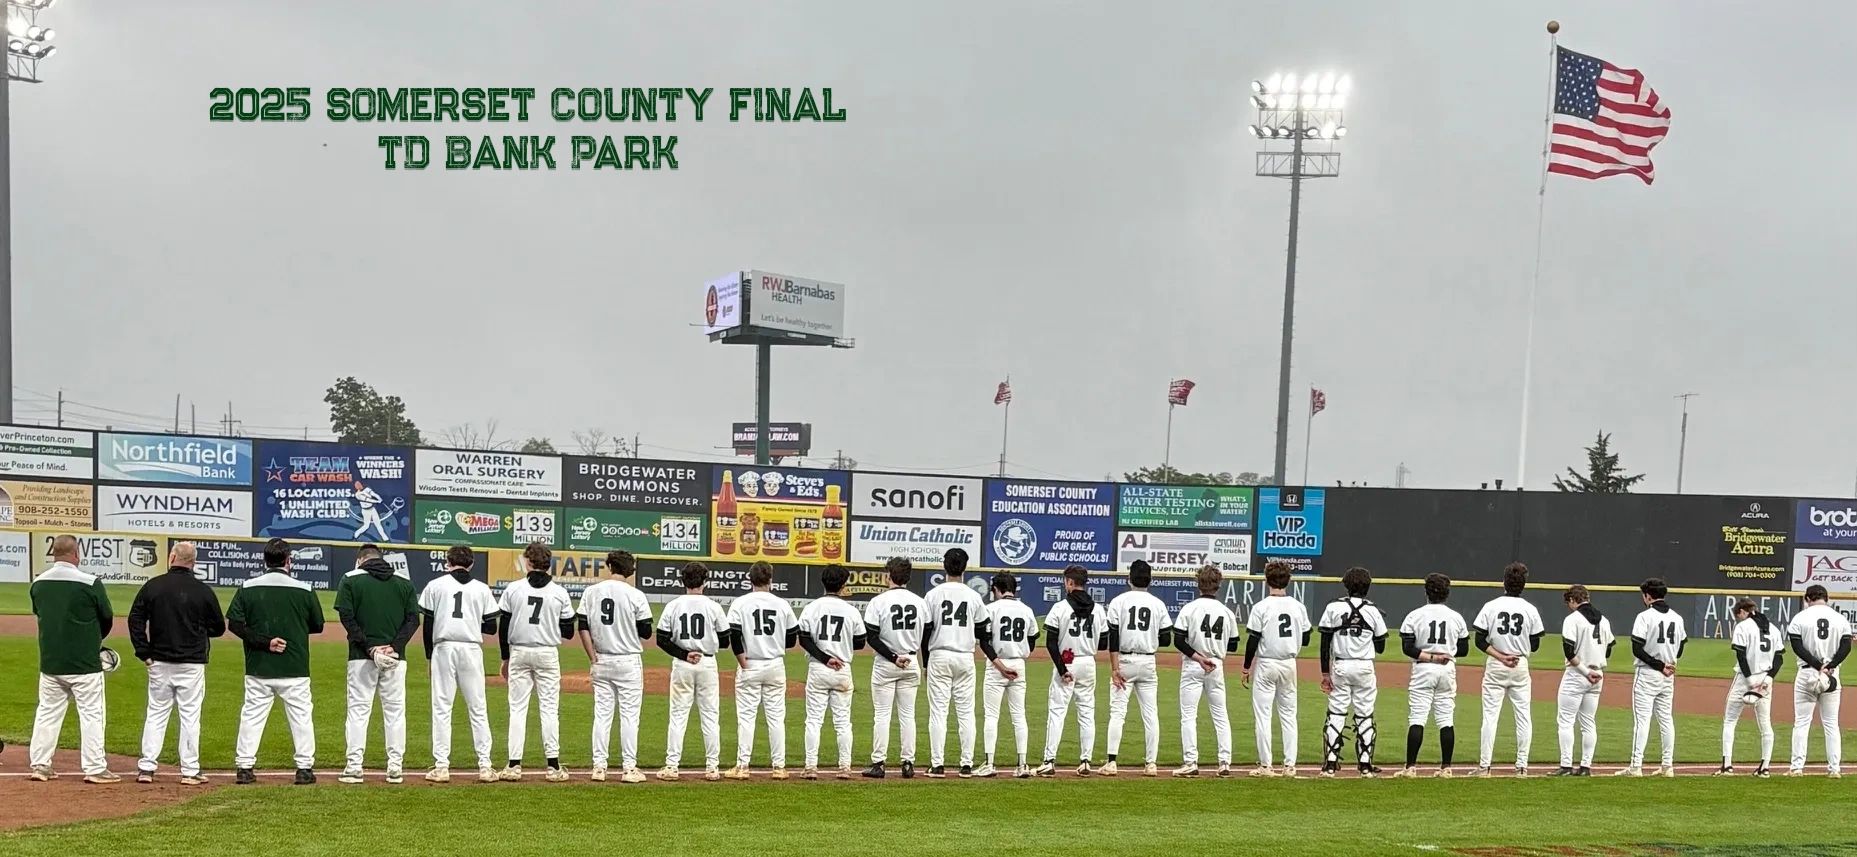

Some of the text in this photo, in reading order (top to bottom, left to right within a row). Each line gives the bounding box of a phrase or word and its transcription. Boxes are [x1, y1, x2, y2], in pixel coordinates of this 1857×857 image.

[762, 276, 835, 301] RWJBarnabas
[771, 292, 803, 305] HEALTH
[41, 446, 72, 455] Collection
[112, 439, 237, 465] Northfield
[11, 460, 68, 471] Peace of Mind.
[290, 456, 350, 474] TEAM
[355, 460, 405, 469] WINNERS
[456, 453, 522, 467] WARREN
[202, 466, 236, 479] Bank
[289, 473, 353, 483] CAR WASH
[359, 468, 403, 479] WASH!
[432, 464, 545, 480] ORAL SURGERY
[579, 463, 696, 480] BRIDGEWATER
[454, 478, 506, 486] COMPASSIONATE
[594, 478, 680, 493] COMMONS
[785, 474, 825, 487] Steve's
[28, 494, 66, 502] Construction
[53, 487, 85, 495] Landscape
[273, 488, 355, 498] 16 LOCATIONS.
[449, 485, 468, 493] Teeth
[469, 486, 498, 495] Removal
[530, 490, 559, 498] Implants
[870, 484, 964, 511] sanofi
[1006, 484, 1097, 500] SOMERSET COUNTY
[1123, 487, 1183, 498] ALL-STATE
[117, 493, 233, 513] WYNDHAM
[279, 500, 350, 510] 1 UNLIMITED
[572, 492, 702, 506] SHOP. DINE. DISCOVER.
[1123, 497, 1215, 508] WATER TESTING
[18, 505, 89, 516] 908-252-1550
[280, 509, 350, 519] WASH CLUB.
[992, 500, 1110, 517] EDUCATION ASSOCIATION
[1122, 506, 1189, 516] SERVICES, LLC
[15, 518, 92, 528] Topsoil Mulch Stones
[128, 519, 222, 530] HOTELS & RESORTS
[470, 515, 499, 527] MEGA
[1194, 520, 1248, 528] allstatewell.com
[1276, 515, 1307, 534] VIP
[424, 527, 445, 535] Lottery
[860, 524, 907, 542] Union
[908, 526, 973, 544] Catholic
[1055, 530, 1095, 540] PROUD OF
[1823, 528, 1857, 539] at your
[515, 535, 553, 543] MILLION
[662, 541, 699, 550] MILLION
[1121, 533, 1148, 549] AJ
[1263, 530, 1317, 550] Honda
[1725, 532, 1787, 545] Bridgewater
[78, 538, 125, 559] WEST
[910, 546, 941, 555] SCHOOL
[1052, 541, 1097, 552] OUR GREAT
[1731, 541, 1775, 555] Acura
[208, 551, 250, 560] COLLISIONS
[1039, 552, 1067, 562] PUBLIC
[1069, 553, 1109, 563] SCHOOLS!
[1147, 551, 1208, 565] JERSEY
[90, 559, 111, 567] GRILL
[232, 561, 245, 569] Body
[1223, 562, 1248, 571] Bobcat
[452, 590, 464, 619] 1
[527, 595, 544, 625] 7
[600, 597, 615, 626] 9
[890, 604, 918, 631] 22
[941, 600, 968, 627] 24
[1127, 605, 1152, 632] 19
[679, 612, 705, 640] 10
[752, 608, 777, 636] 15
[819, 614, 845, 642] 17
[1068, 612, 1095, 639] 34
[1200, 613, 1224, 640] 44
[1278, 613, 1292, 638] 2
[1496, 611, 1524, 637] 33
[1816, 618, 1830, 640] 8
[1000, 616, 1026, 643] 28
[1427, 620, 1447, 645] 11
[1592, 623, 1602, 645] 4
[1657, 620, 1676, 645] 14
[1759, 631, 1772, 653] 5
